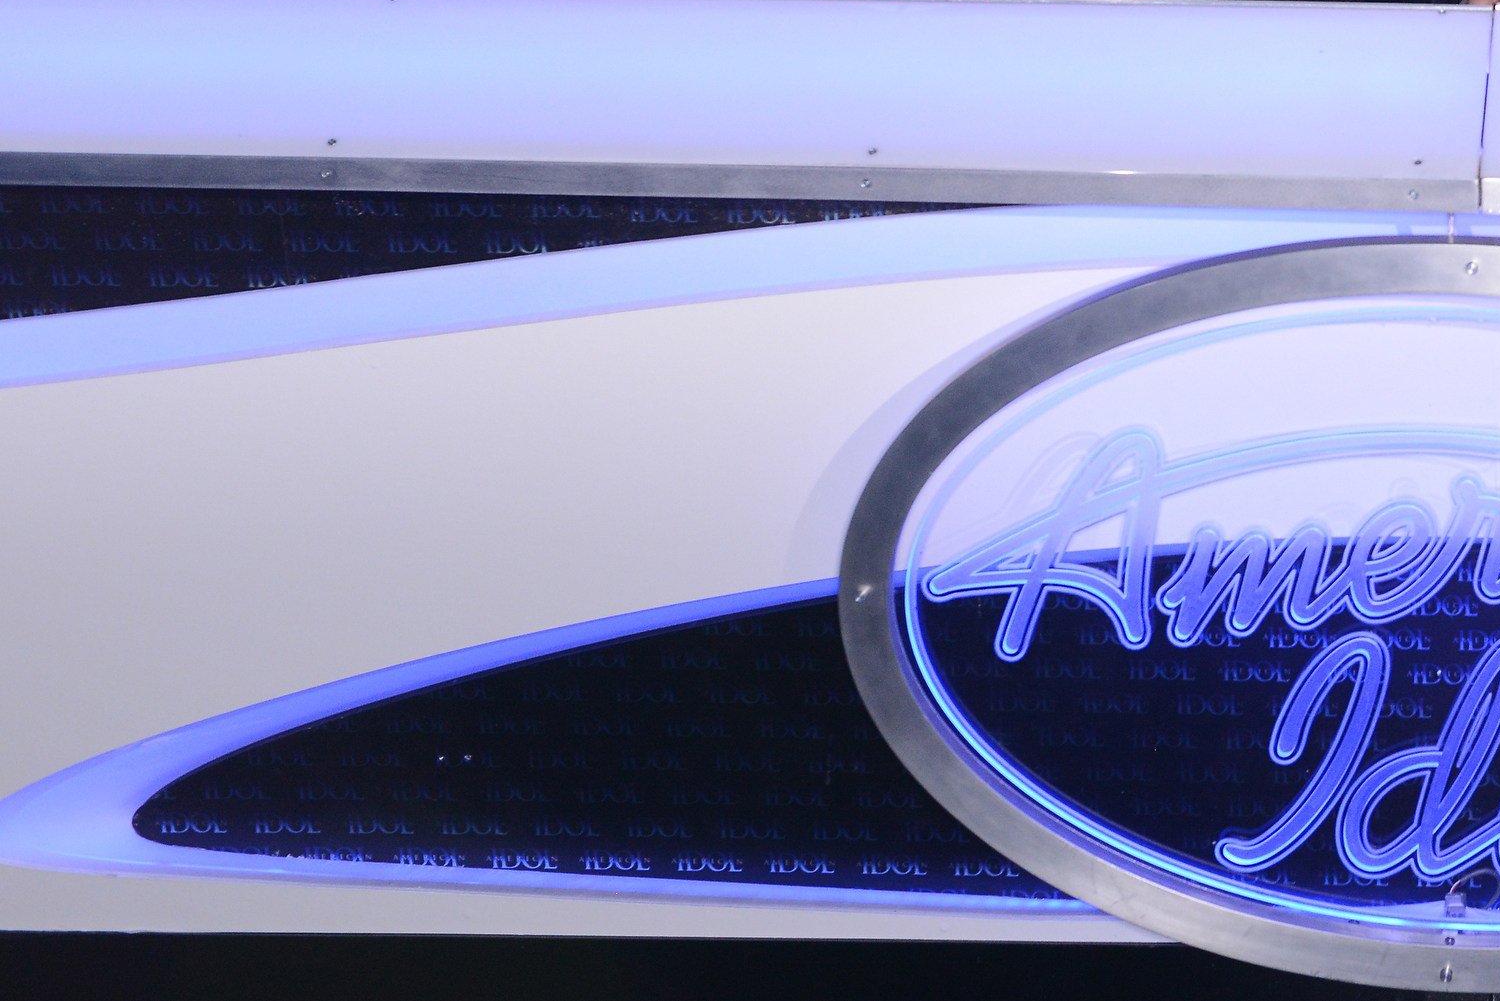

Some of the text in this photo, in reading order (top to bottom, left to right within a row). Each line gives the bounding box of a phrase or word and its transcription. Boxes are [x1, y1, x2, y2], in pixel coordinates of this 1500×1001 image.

[1034, 656, 1102, 680] IDOL
[1128, 657, 1196, 681] IDOL
[1223, 658, 1291, 682] IDOL
[1082, 690, 1150, 714] IDOL
[1176, 692, 1244, 716] IDOL
[1380, 695, 1433, 719] DOL
